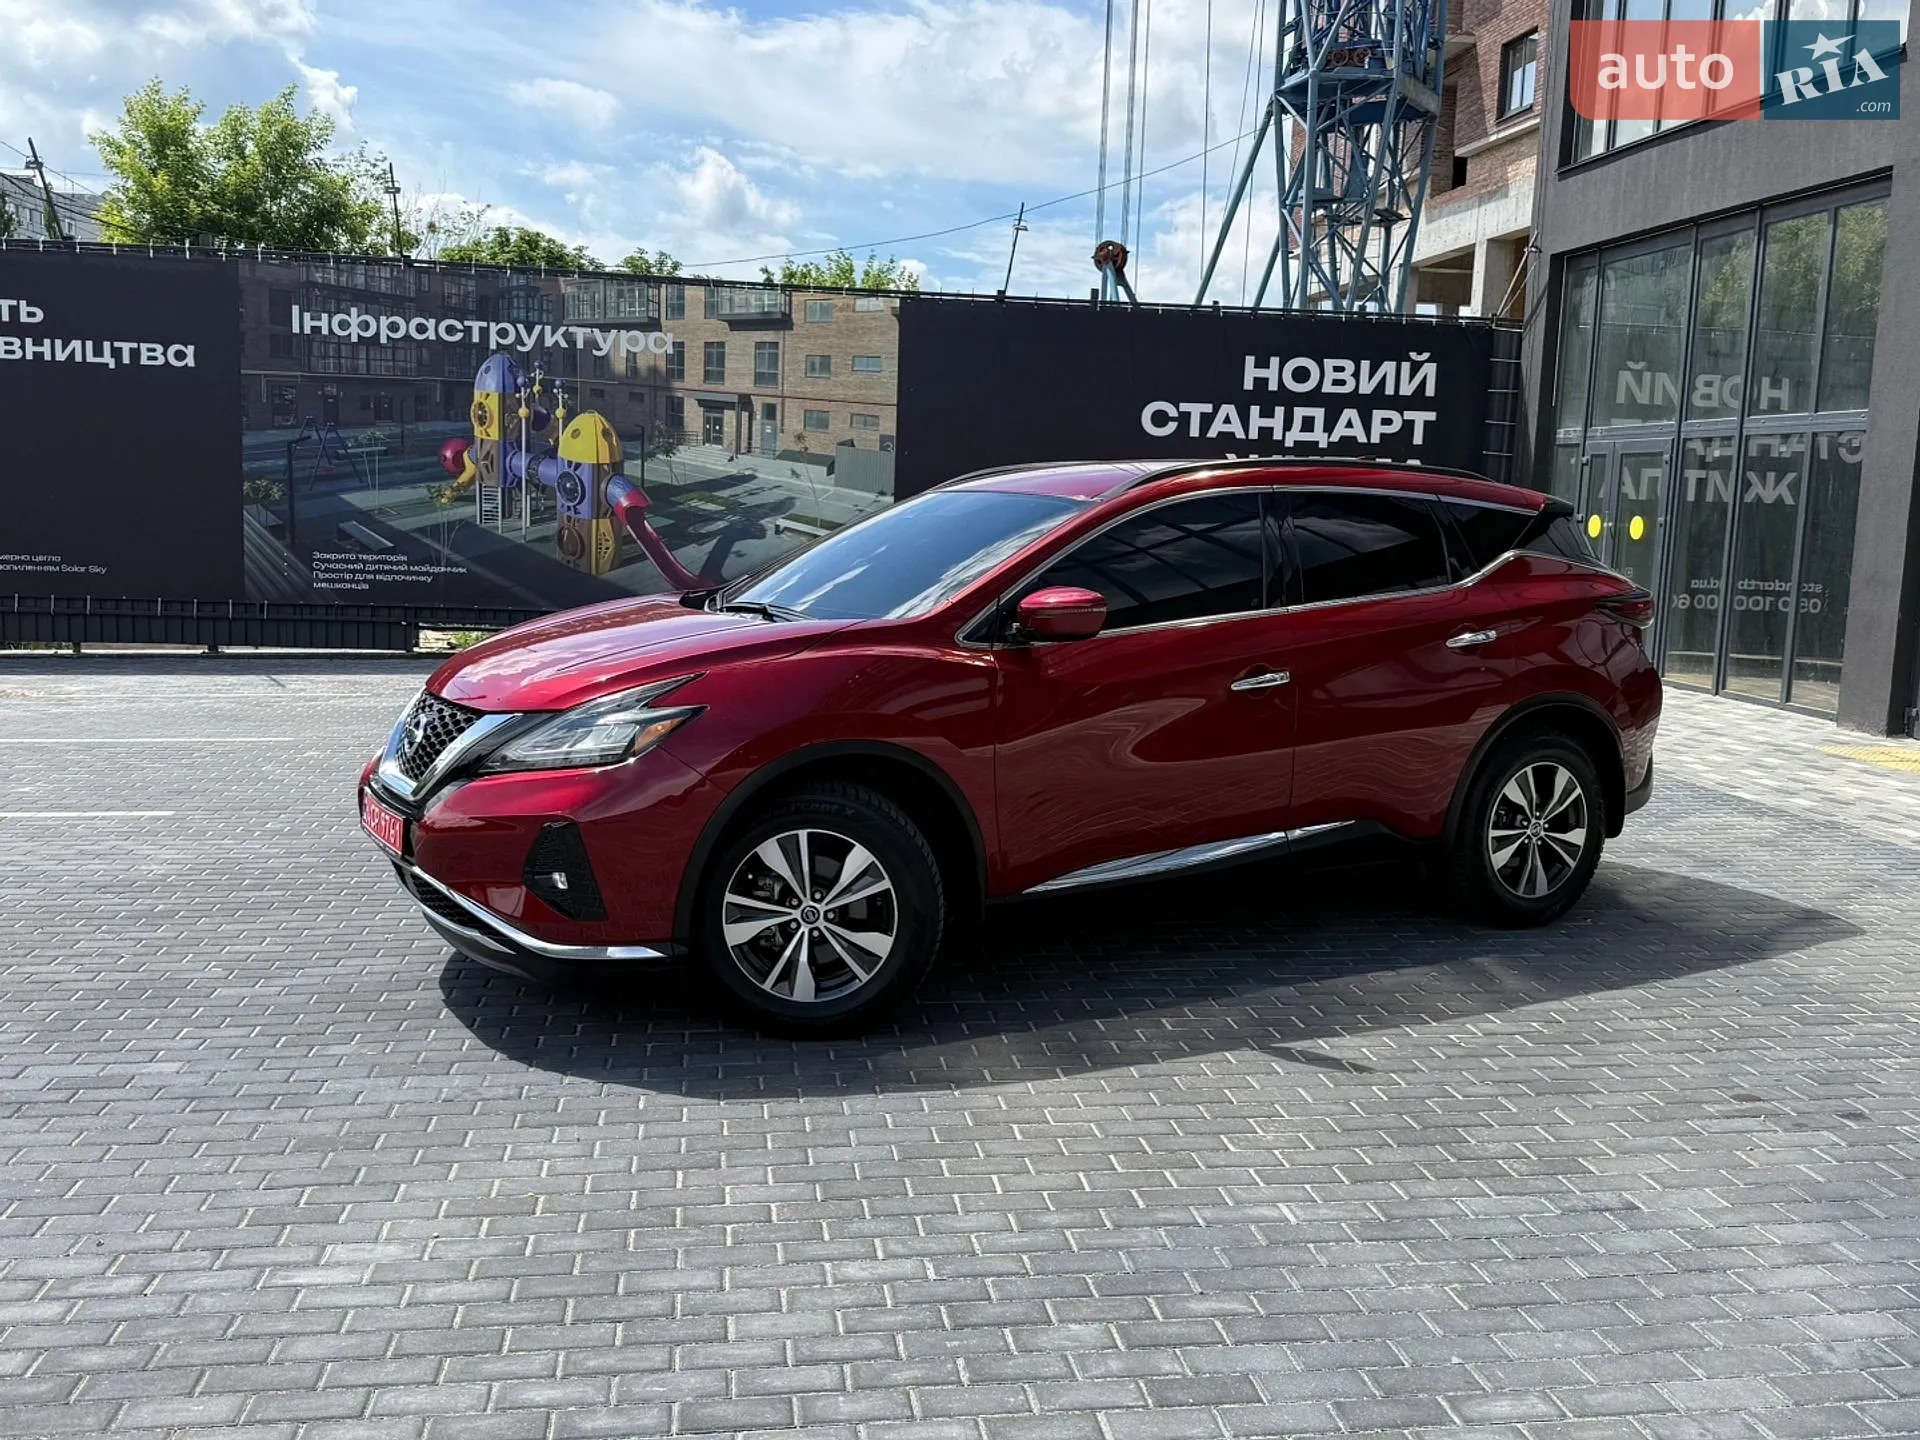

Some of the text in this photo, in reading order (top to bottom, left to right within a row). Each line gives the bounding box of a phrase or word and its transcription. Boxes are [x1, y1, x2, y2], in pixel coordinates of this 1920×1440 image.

[291, 304, 673, 357] Інфраструктура
[0, 336, 196, 369] вництва
[1243, 351, 1438, 397] НОВИЙ
[1140, 401, 1438, 448] СТАНДАРТ
[312, 551, 408, 561] Закрита територія
[61, 564, 87, 573] Solar
[88, 565, 107, 574] Sky
[313, 561, 364, 570] Сучасний
[409, 563, 468, 573] майданчик
[313, 570, 433, 583] Простір для відпочинку
[313, 582, 370, 590] мешканців
